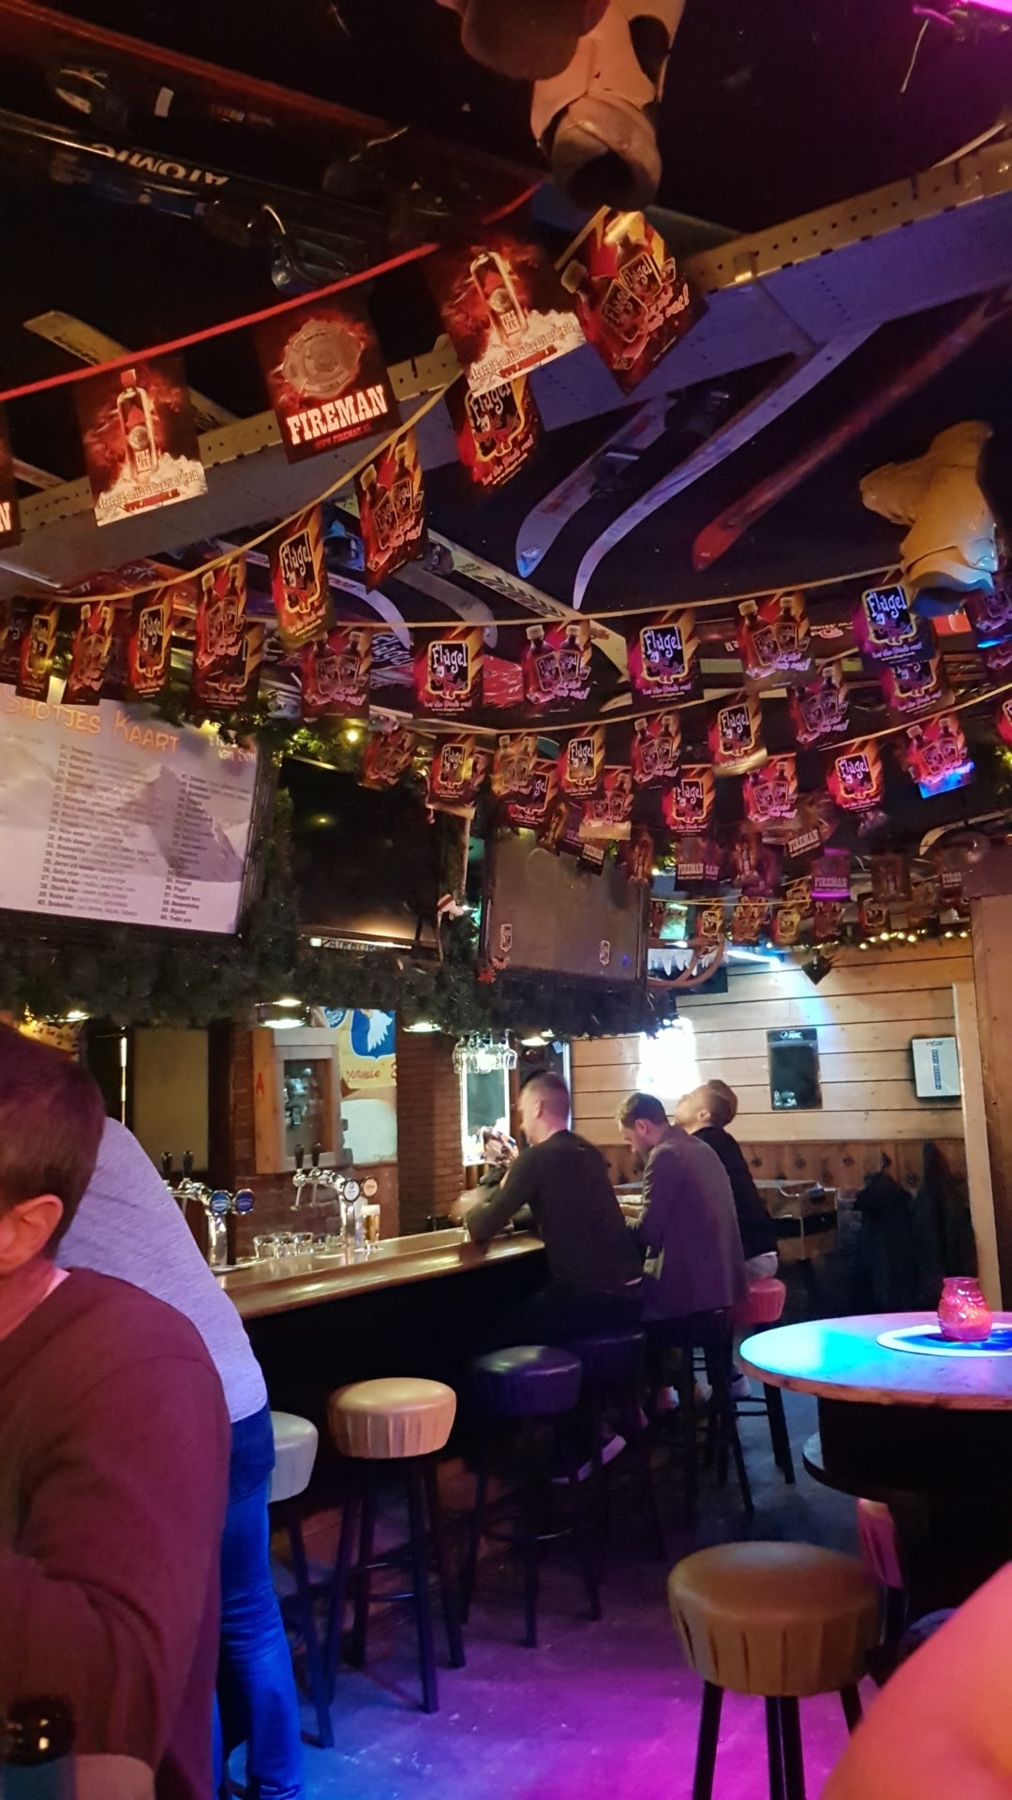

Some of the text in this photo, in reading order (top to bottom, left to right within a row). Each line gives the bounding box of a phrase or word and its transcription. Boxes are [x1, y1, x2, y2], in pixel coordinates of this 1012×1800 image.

[92, 143, 229, 186] ATOMIC
[286, 384, 388, 445] FIREMAN
[867, 583, 907, 618] Flügel
[432, 643, 467, 673] Flügel
[645, 625, 682, 658] Flügel
[2, 695, 180, 752] SHOTJES KAART
[721, 705, 749, 738] Flügel
[571, 739, 594, 767] Flügel
[840, 753, 869, 780] Flügel
[788, 829, 820, 852] FIREMAN
[814, 876, 848, 888] FIREMAN
